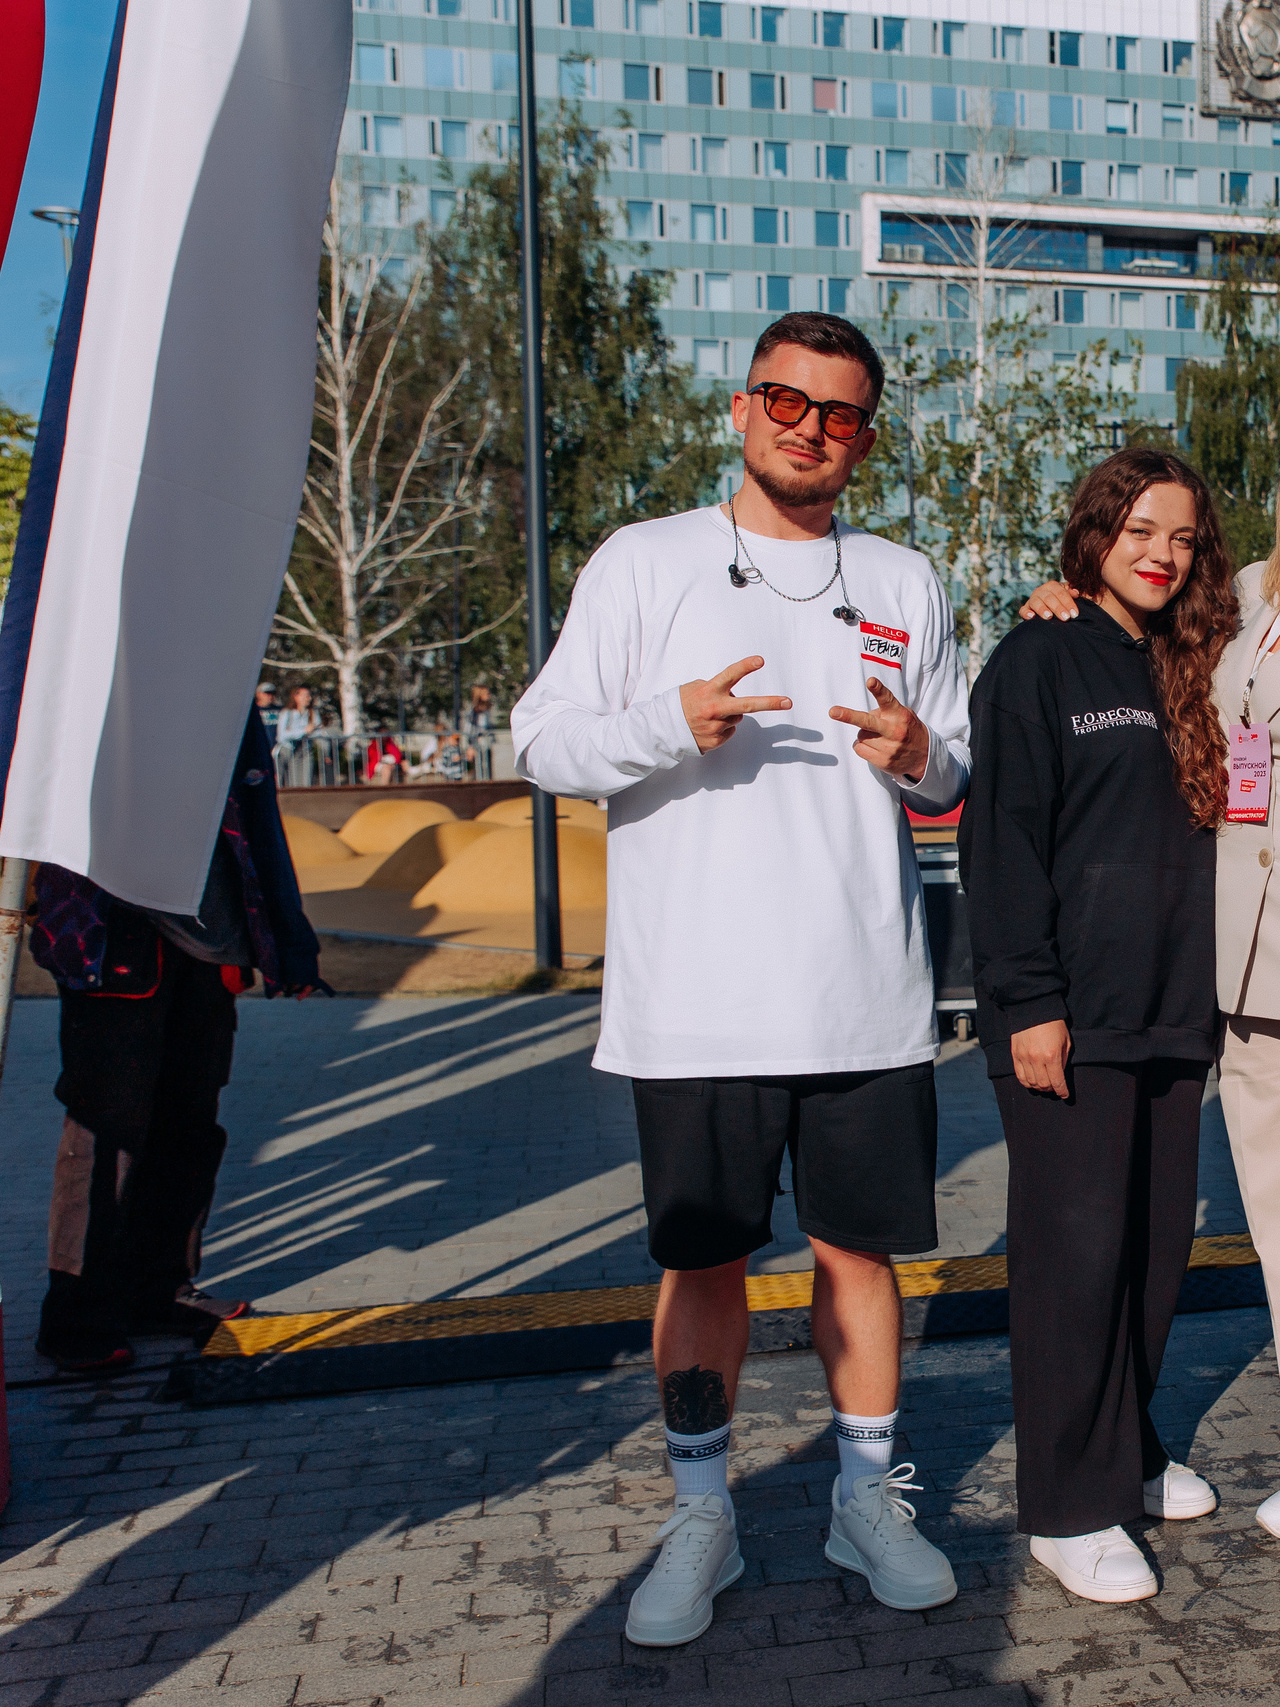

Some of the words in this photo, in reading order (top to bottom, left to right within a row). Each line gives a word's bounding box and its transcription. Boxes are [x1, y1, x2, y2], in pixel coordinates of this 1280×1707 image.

[873, 625, 903, 637] HELLO
[1074, 719, 1132, 736] PRODUCTION
[1134, 718, 1158, 730] CENTER
[1233, 761, 1267, 770] ВЫПУСКНОЙ
[1253, 770, 1267, 778] 2023
